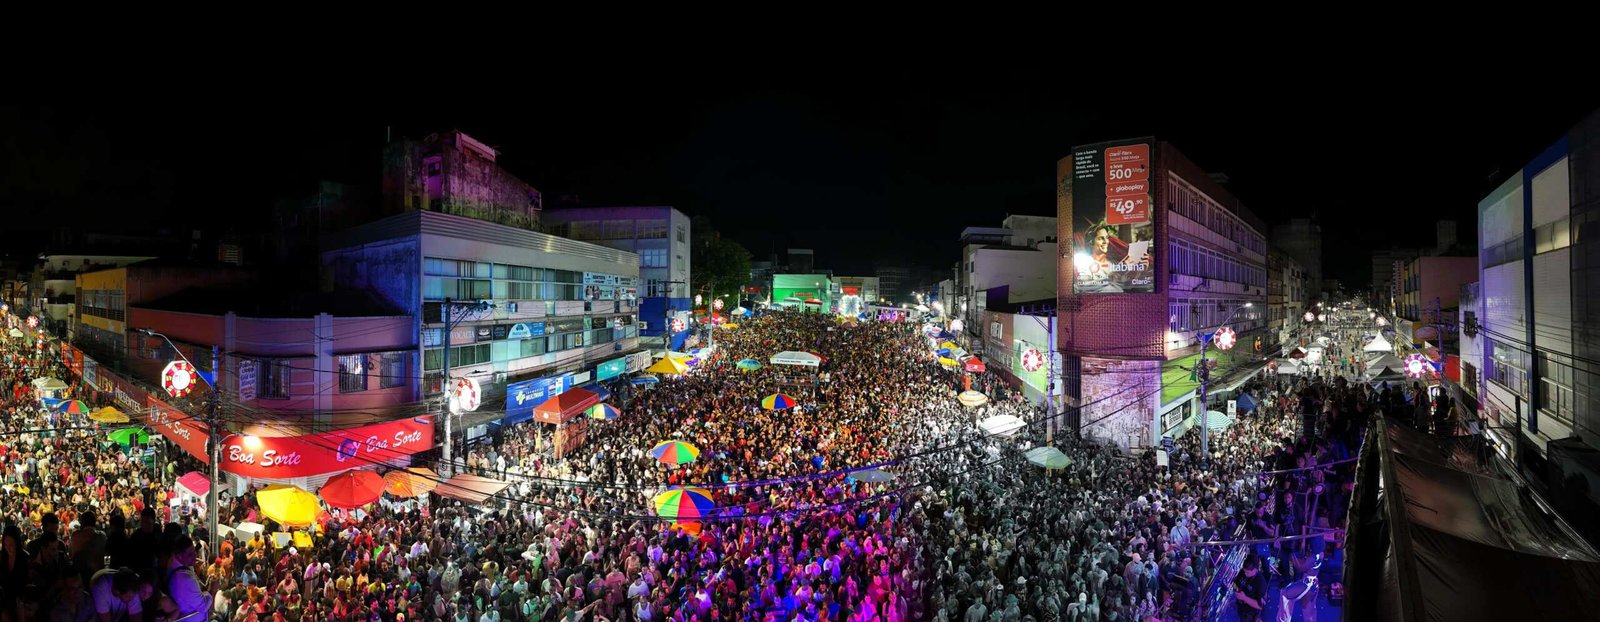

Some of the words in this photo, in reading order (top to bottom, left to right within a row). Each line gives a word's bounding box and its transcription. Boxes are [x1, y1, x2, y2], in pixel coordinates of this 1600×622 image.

[1110, 168, 1132, 180] 500
[1116, 184, 1144, 192] globoplay
[1115, 200, 1135, 214] 49
[1110, 262, 1144, 271] Itabuna
[115, 387, 141, 413] PRESENTES
[161, 413, 172, 430] Boa
[173, 421, 191, 441] Sorte
[366, 435, 388, 453] Boa
[392, 430, 422, 447] Sorte
[229, 445, 256, 465] Boa
[260, 449, 301, 467] Sorte
